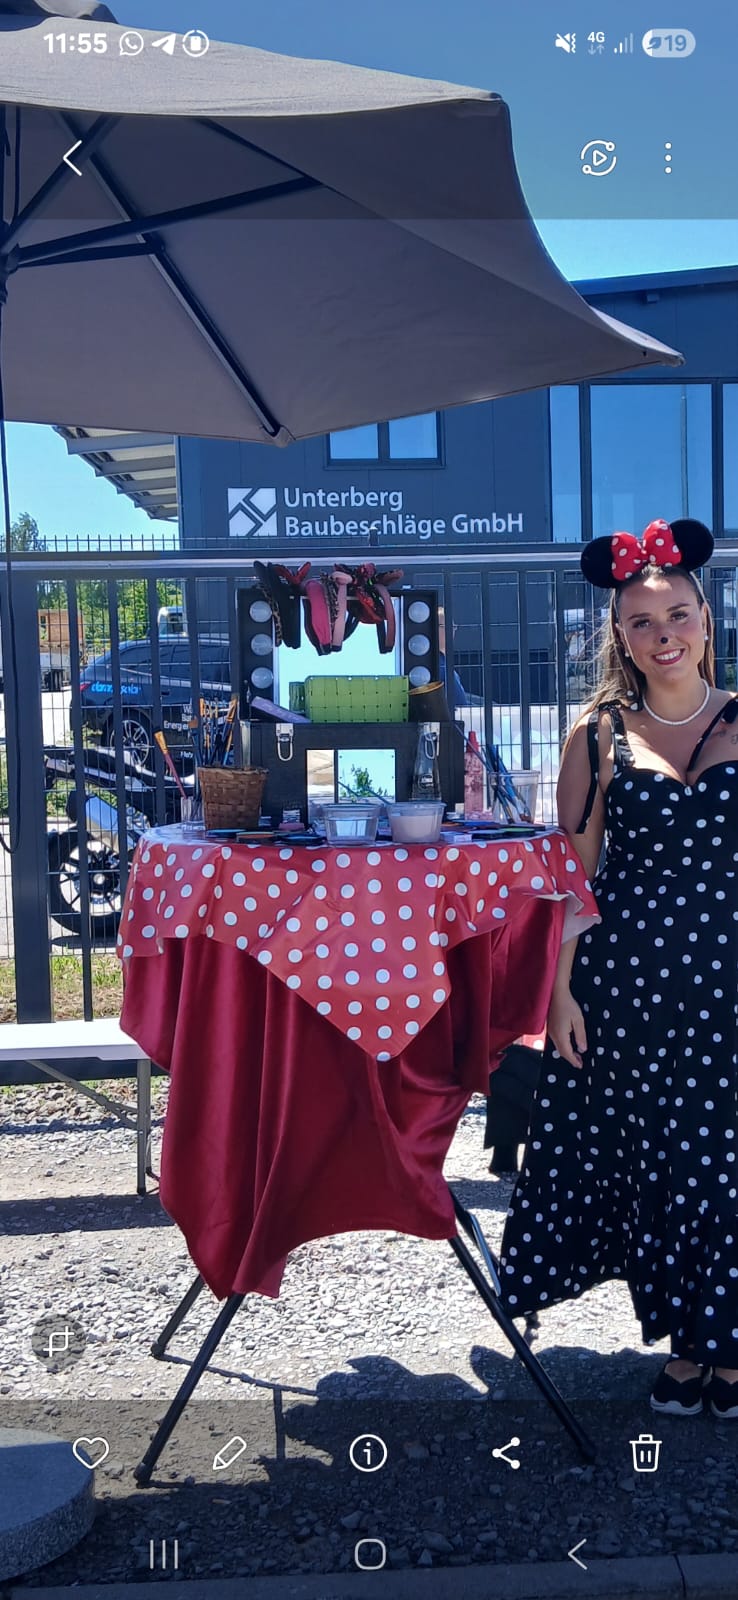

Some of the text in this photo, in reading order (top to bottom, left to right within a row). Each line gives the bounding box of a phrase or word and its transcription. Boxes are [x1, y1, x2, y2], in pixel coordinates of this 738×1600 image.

[283, 486, 404, 511] Unterberg
[284, 512, 524, 539] Baubeschläge GmbH
